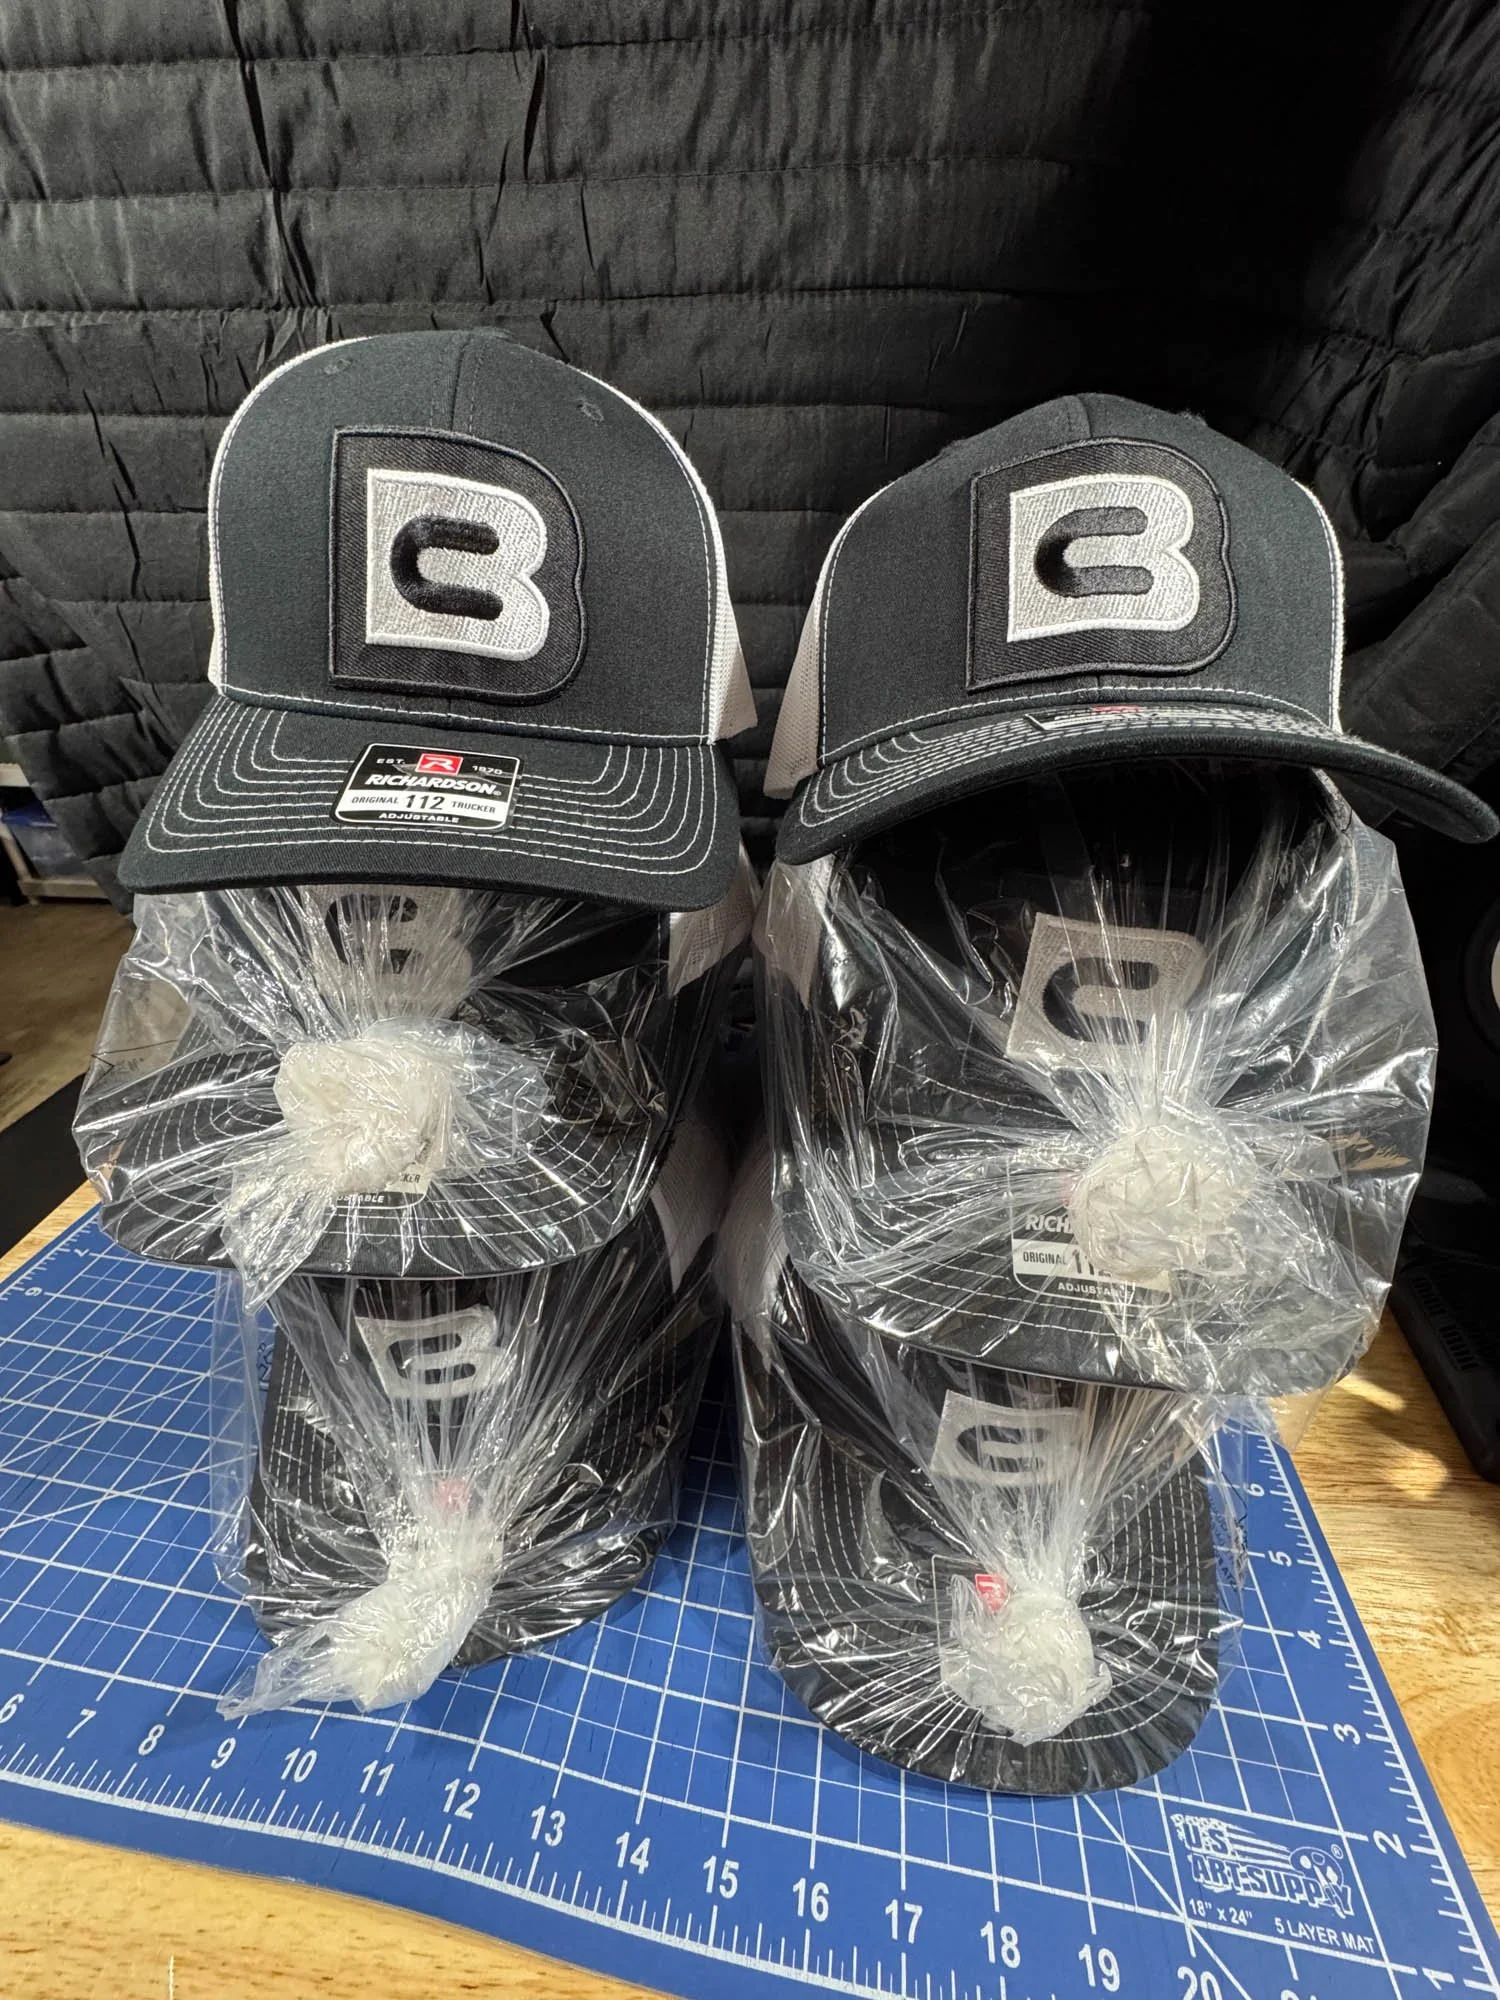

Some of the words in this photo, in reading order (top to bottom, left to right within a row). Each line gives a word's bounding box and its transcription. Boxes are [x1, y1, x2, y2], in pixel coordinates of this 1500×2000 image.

[376, 757, 406, 765] EST.
[471, 764, 504, 775] 1970
[364, 773, 497, 795] RICHARDSON
[351, 796, 399, 805] ORIGINAL
[405, 794, 446, 811] 112
[452, 800, 496, 814] TRUCKER
[379, 812, 459, 823] ADJUSTABLE
[1023, 1250, 1067, 1265] ORIGINAL
[1243, 1482, 1265, 1497] 6
[1268, 1550, 1293, 1567] 5
[1297, 1630, 1322, 1649] 4
[1333, 1722, 1361, 1745] 3
[0, 1693, 25, 1724] 6
[67, 1708, 97, 1739] 7
[138, 1724, 165, 1756] 8
[210, 1737, 237, 1769] 9
[280, 1747, 318, 1783] 10
[360, 1759, 395, 1797] 11
[443, 1778, 481, 1820] 12
[531, 1805, 566, 1847] 13
[615, 1831, 651, 1875] 14
[703, 1855, 740, 1899] 15
[792, 1877, 830, 1922] 16
[885, 1898, 923, 1944] 17
[980, 1920, 1021, 1969] 18
[1078, 1943, 1121, 1993] 19
[1373, 1829, 1408, 1859] 2
[1274, 1917, 1285, 1935] 5
[1287, 1920, 1340, 1947] LAYER
[1342, 1931, 1375, 1955] MAT
[1421, 1967, 1456, 1991] 1
